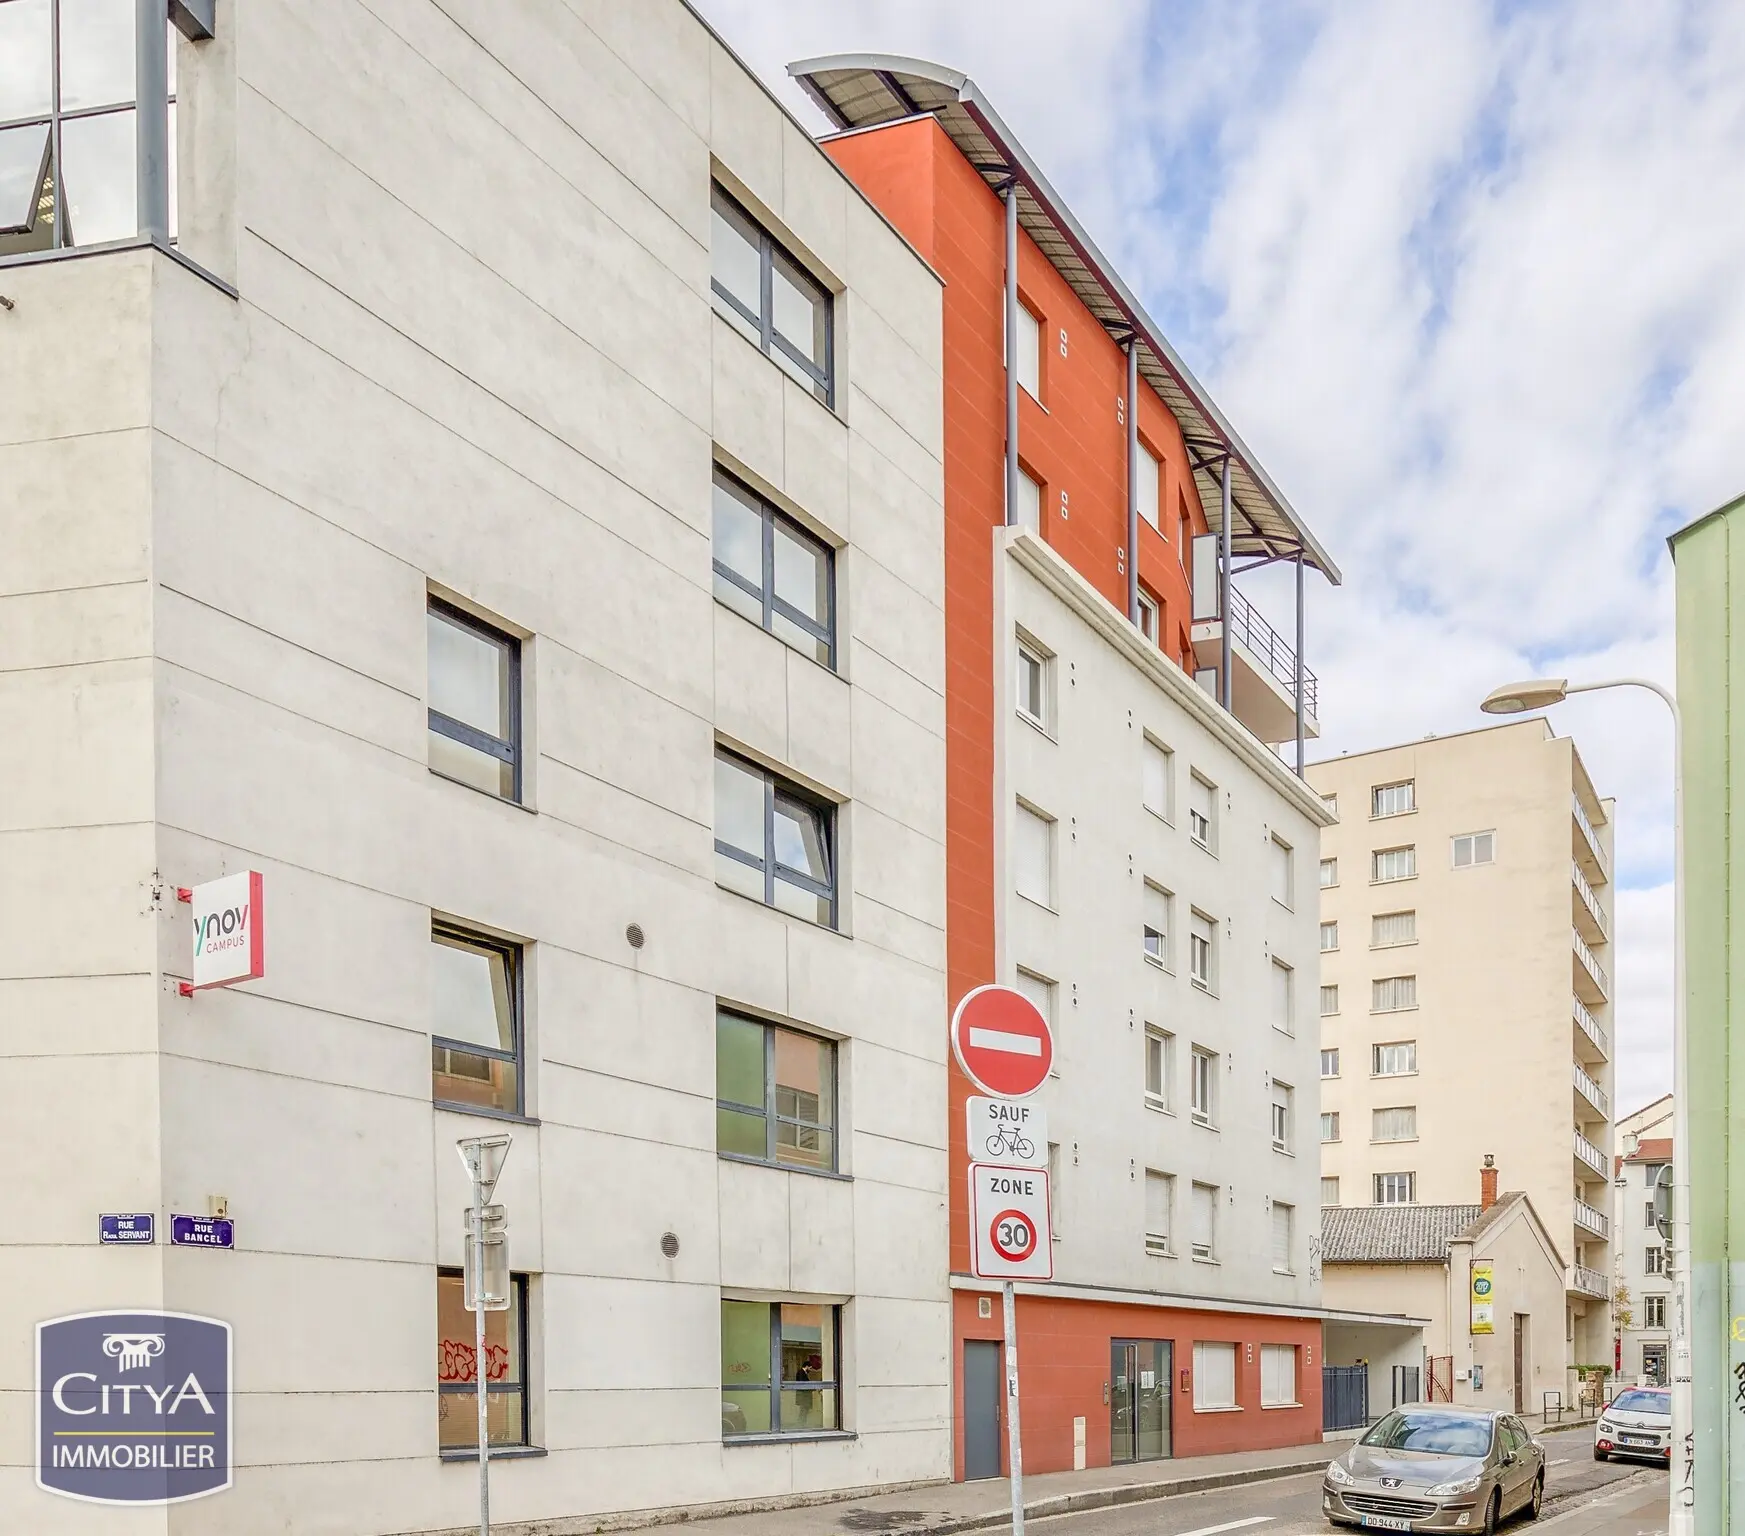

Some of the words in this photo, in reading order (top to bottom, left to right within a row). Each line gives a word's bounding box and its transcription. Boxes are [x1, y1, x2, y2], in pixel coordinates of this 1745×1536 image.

[206, 935, 245, 954] CAMPUS
[989, 1104, 1030, 1122] SAUF
[990, 1177, 1034, 1196] ZONE
[118, 1221, 135, 1230] RUE
[194, 1224, 213, 1233] RUE
[118, 1231, 150, 1239] SERVANT
[184, 1233, 223, 1244] BANCEL
[999, 1223, 1029, 1248] 30
